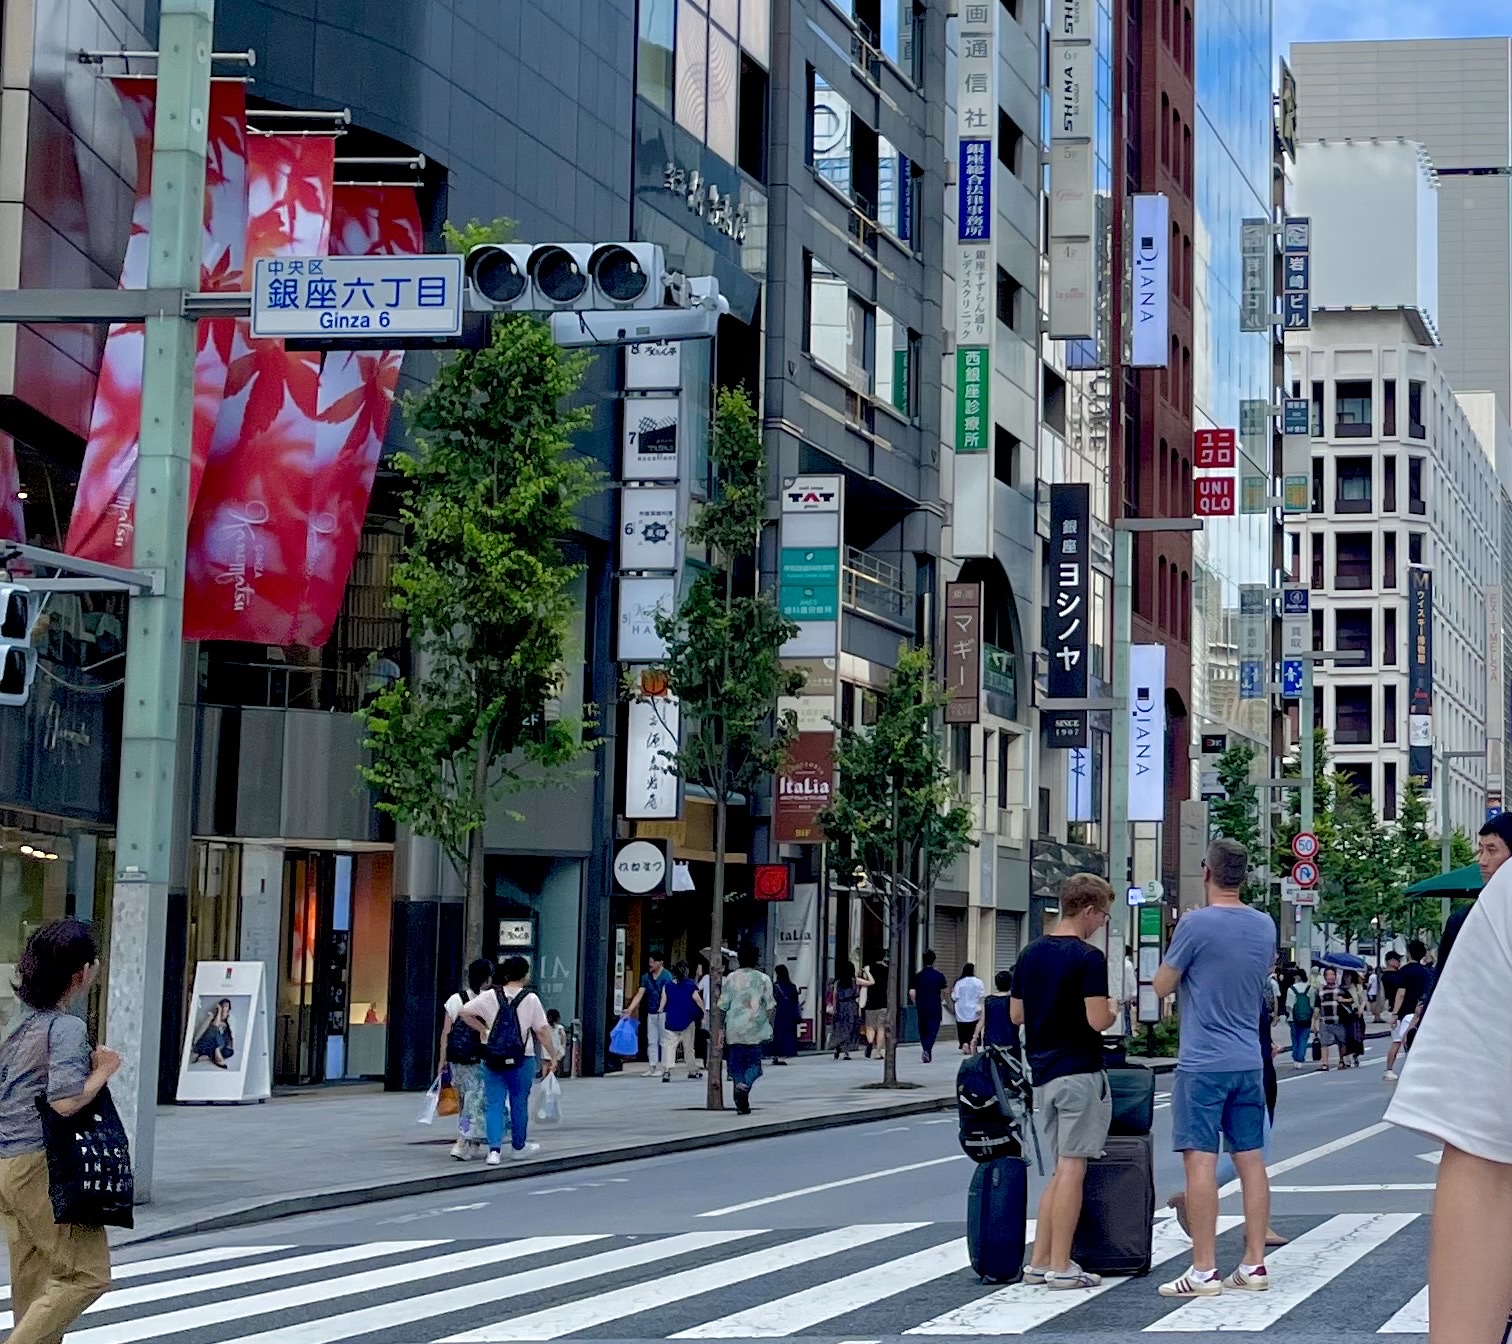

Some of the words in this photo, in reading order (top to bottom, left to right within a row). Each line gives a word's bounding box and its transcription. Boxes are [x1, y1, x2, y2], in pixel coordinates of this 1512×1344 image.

[1063, 67, 1073, 132] SHIMA
[267, 259, 324, 276] 中央区
[1137, 237, 1159, 323] DIANA
[267, 277, 446, 309] 銀座六丁目
[320, 311, 370, 329] Ginza
[379, 311, 391, 328] 6
[964, 350, 980, 448] 西銀座診療所
[1201, 433, 1231, 446] ユニ
[1200, 449, 1231, 463] クロ
[1200, 481, 1229, 495] UNI
[1200, 497, 1231, 513] QLO
[624, 522, 634, 536] 6
[1061, 519, 1078, 554] 銀座
[1056, 562, 1081, 672] ヨシノヤ
[1416, 592, 1426, 664] ウイスキー
[952, 613, 974, 687] マギー
[1133, 687, 1156, 776] DIANA
[1298, 839, 1313, 852] 50
[1148, 881, 1155, 893] 5
